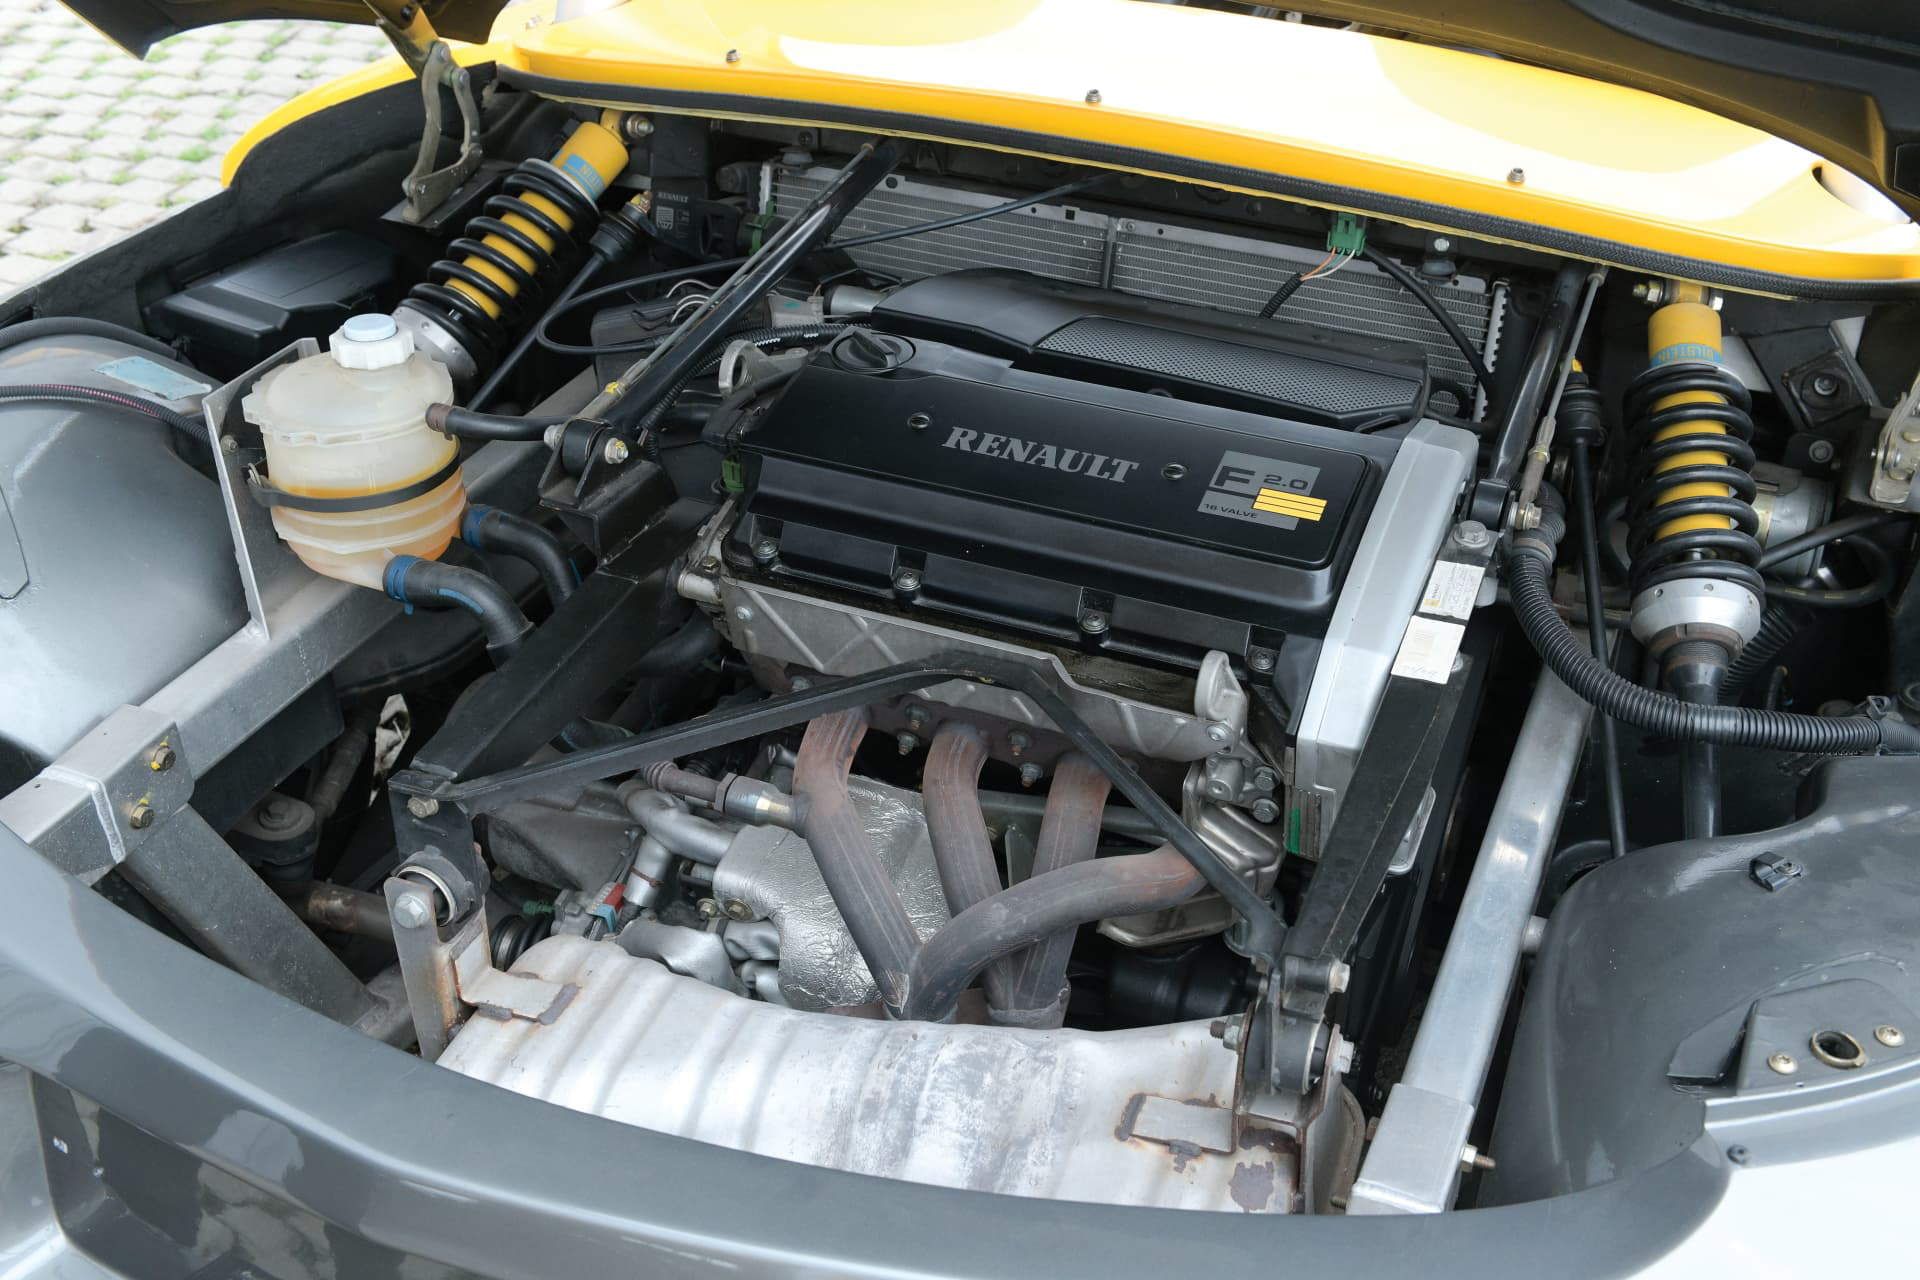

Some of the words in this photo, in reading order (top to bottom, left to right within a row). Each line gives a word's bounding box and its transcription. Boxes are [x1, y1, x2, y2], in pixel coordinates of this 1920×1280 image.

[941, 426, 1140, 483] RENAULT
[1213, 465, 1256, 487] F
[1263, 474, 1309, 490] 2.0
[1218, 506, 1257, 519] VALVE
